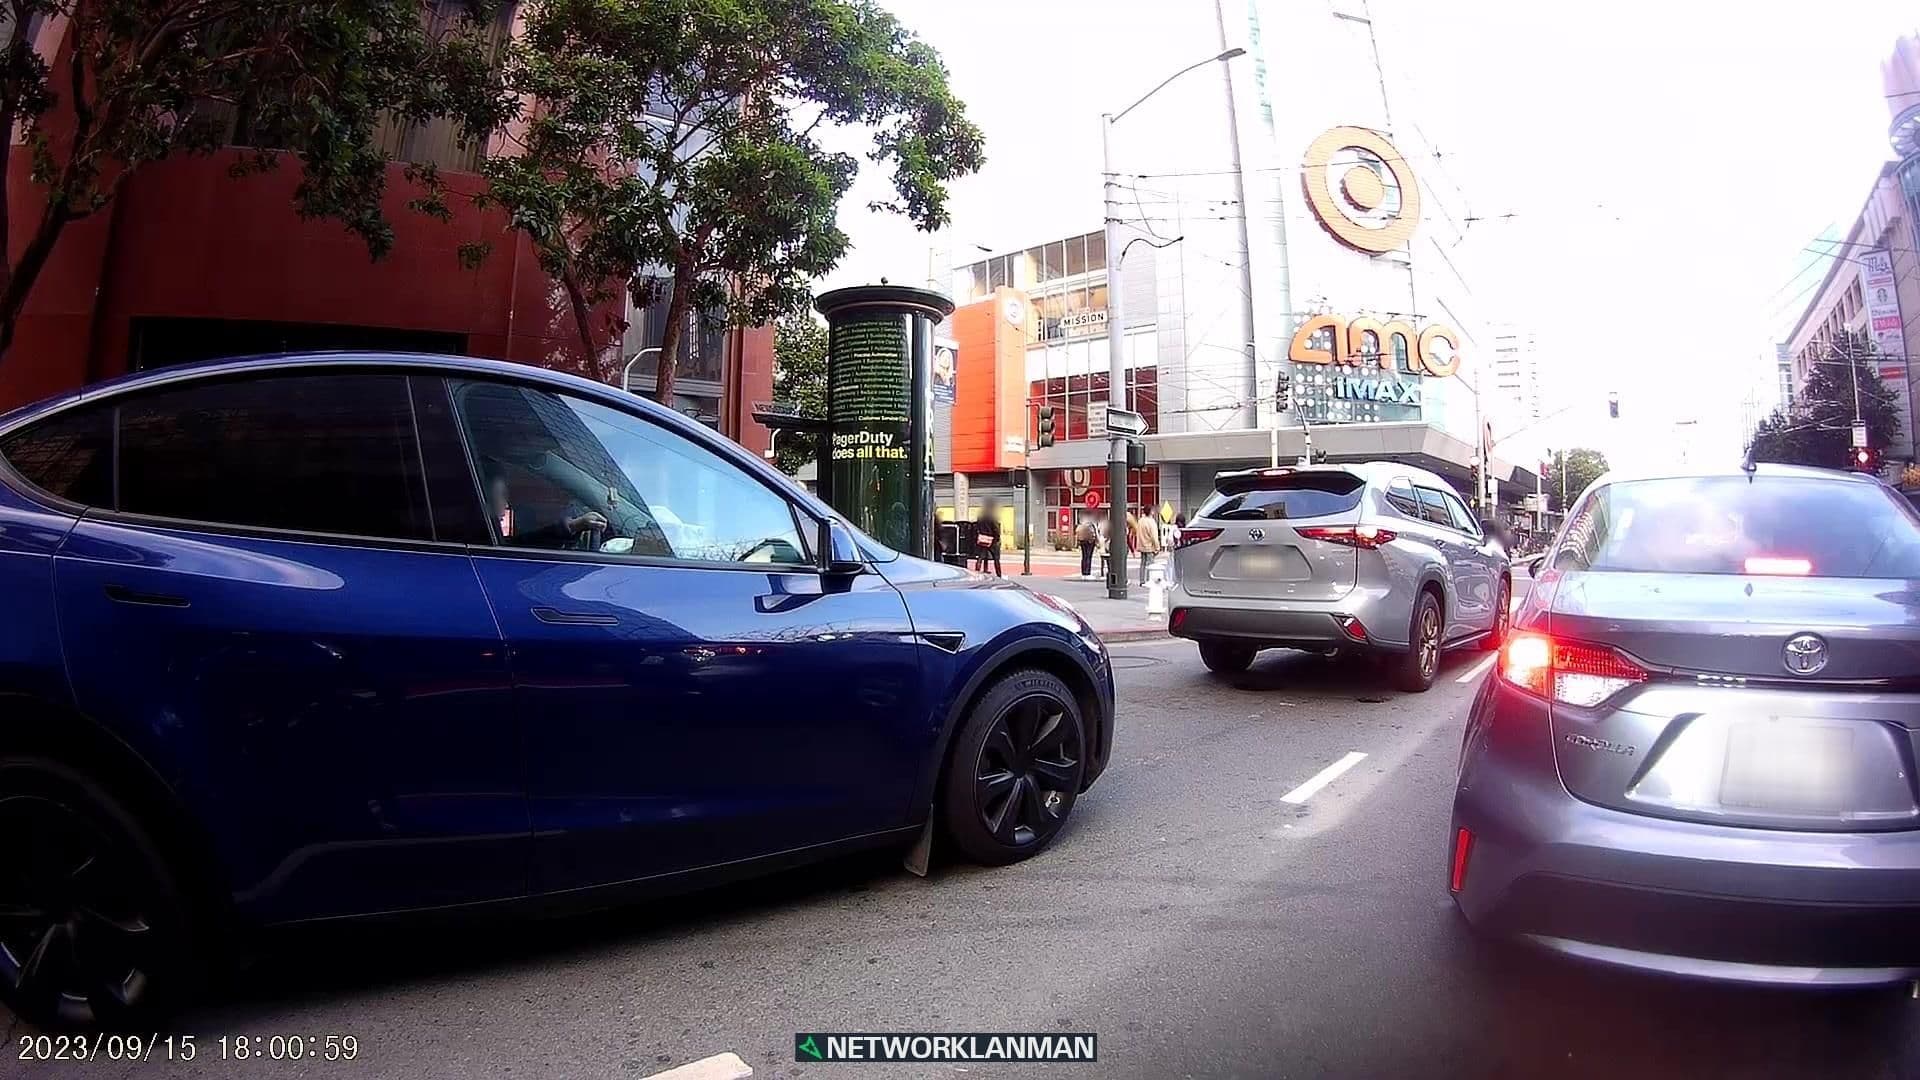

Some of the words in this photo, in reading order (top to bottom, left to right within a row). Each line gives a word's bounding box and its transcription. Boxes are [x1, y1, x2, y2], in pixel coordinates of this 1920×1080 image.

[1063, 313, 1104, 326] MISSION
[856, 446, 872, 458] all
[874, 446, 907, 459] that.
